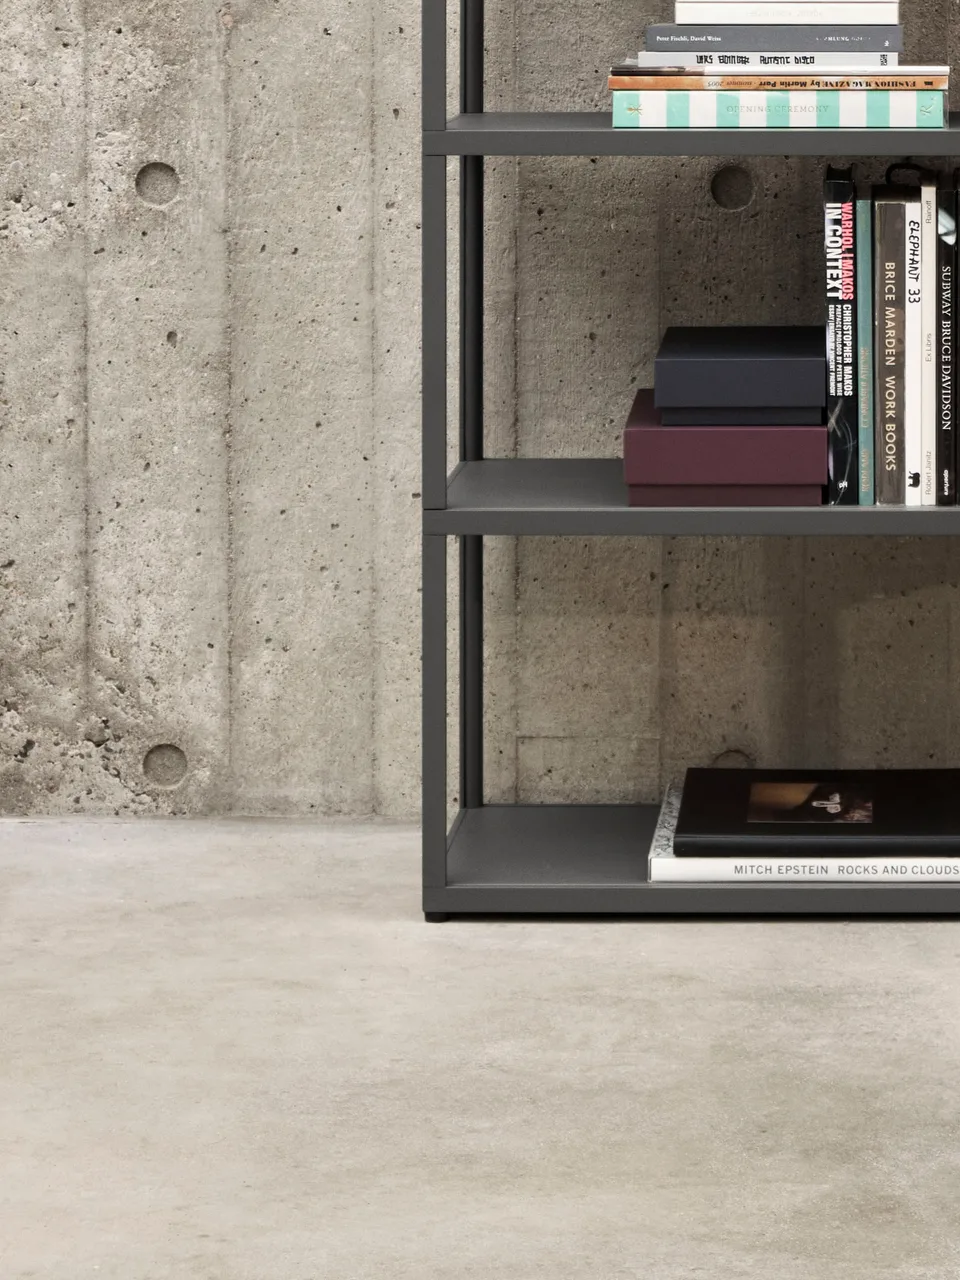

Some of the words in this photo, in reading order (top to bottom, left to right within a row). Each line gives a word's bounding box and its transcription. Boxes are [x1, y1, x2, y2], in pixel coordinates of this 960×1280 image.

[670, 35, 689, 43] Fischli,
[726, 105, 771, 113] OPENING
[774, 105, 829, 113] CEREMONY
[826, 202, 842, 219] IN
[842, 202, 853, 251] WARHOL
[826, 225, 842, 300] CONTEXT
[908, 220, 920, 282] ELEPHANT
[842, 259, 854, 300] MAKOS
[885, 262, 896, 301] BRICE
[908, 288, 920, 304] 33
[942, 266, 951, 316] SUBWAY
[843, 304, 852, 363] CHRISTOPHER
[885, 306, 896, 366] MARDEN
[942, 320, 951, 362] BRUCE
[925, 353, 932, 362] Ex
[843, 366, 853, 396] MAKOS
[885, 376, 896, 418] WORK
[942, 365, 951, 430] DAVIDSON
[885, 423, 896, 471] BOOKS
[734, 865, 772, 875] MITCH
[777, 865, 829, 875] EPSTEIN
[837, 865, 878, 875] ROCKS
[882, 865, 908, 875] AND
[911, 865, 960, 875] CLOUDS
